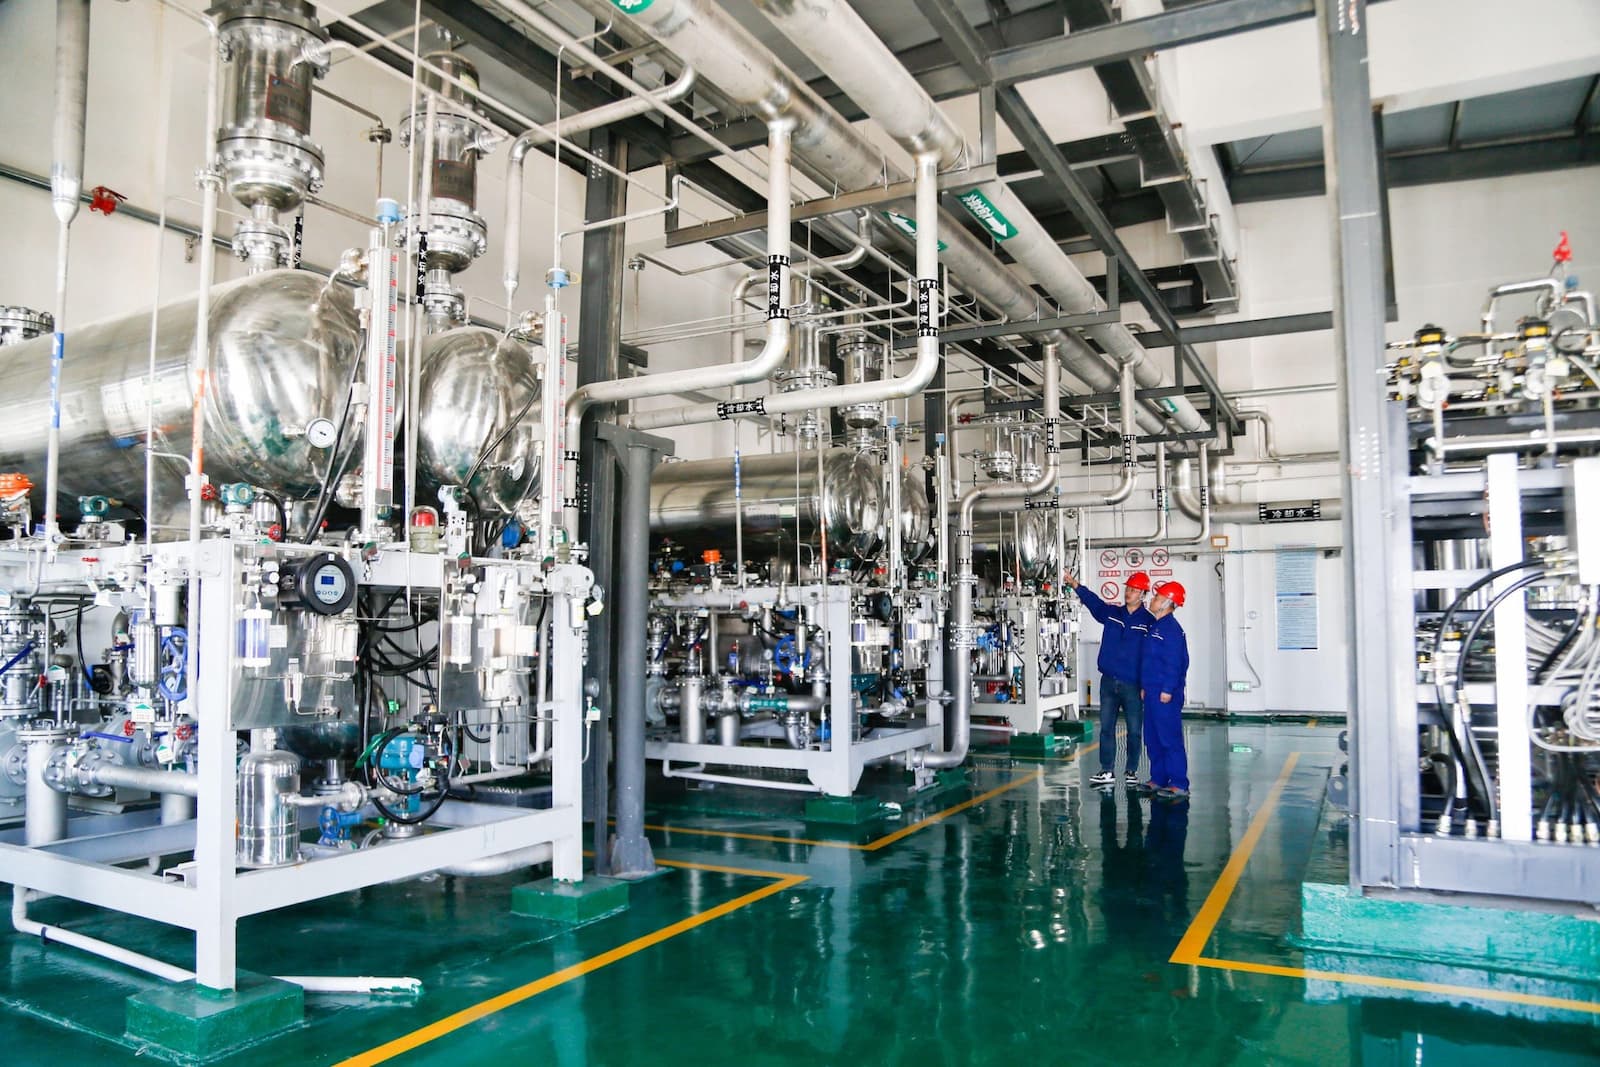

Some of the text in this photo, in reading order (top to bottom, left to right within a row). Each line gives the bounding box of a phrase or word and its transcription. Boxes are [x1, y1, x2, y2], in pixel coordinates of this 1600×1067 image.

[770, 270, 779, 305] 冷却水
[920, 291, 928, 325] 冷却水
[727, 403, 753, 413] 冷却水
[1272, 508, 1306, 518] 冷却水
